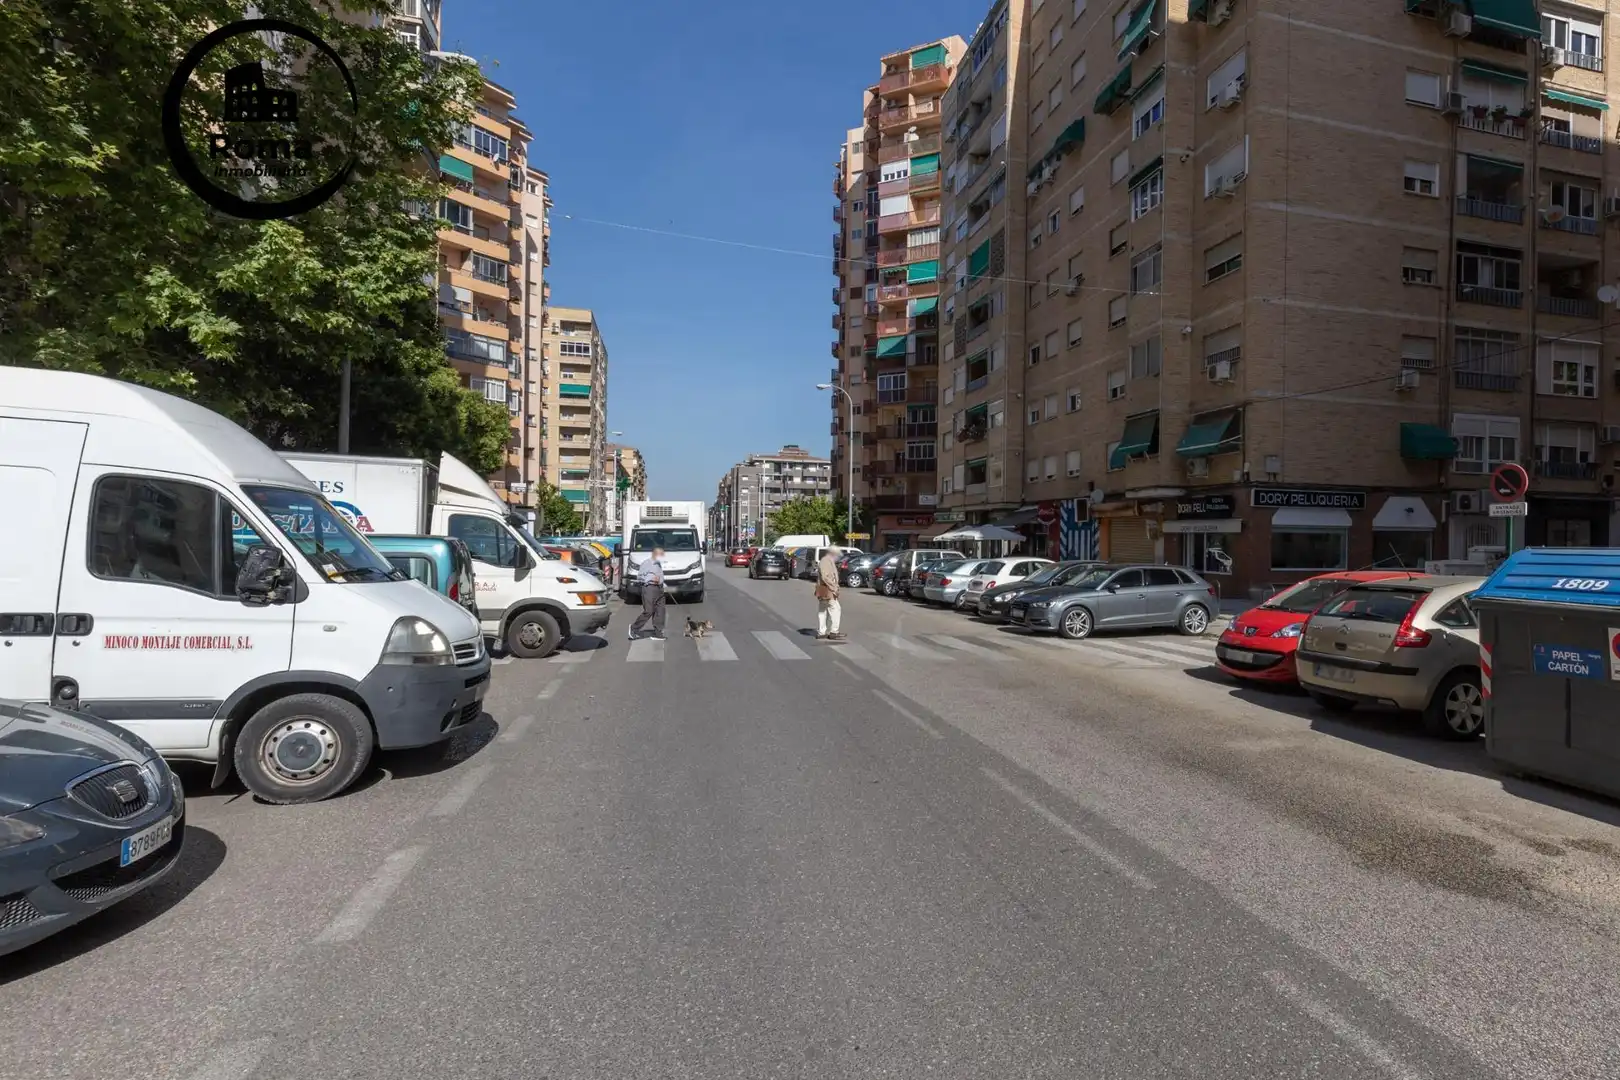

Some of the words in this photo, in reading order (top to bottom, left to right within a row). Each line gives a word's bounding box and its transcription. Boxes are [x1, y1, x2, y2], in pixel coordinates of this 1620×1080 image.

[320, 480, 344, 493] ES
[1260, 492, 1288, 505] DORY
[1290, 494, 1359, 506] PELUQUERIA
[1552, 578, 1609, 590] 1809
[104, 635, 138, 648] MINOCO
[141, 635, 181, 649] MONTAJE
[184, 635, 234, 650] COMERCIAL,
[237, 636, 253, 649] S.L.
[1552, 650, 1584, 662] PAPEL
[1548, 661, 1589, 676] CARTÓN
